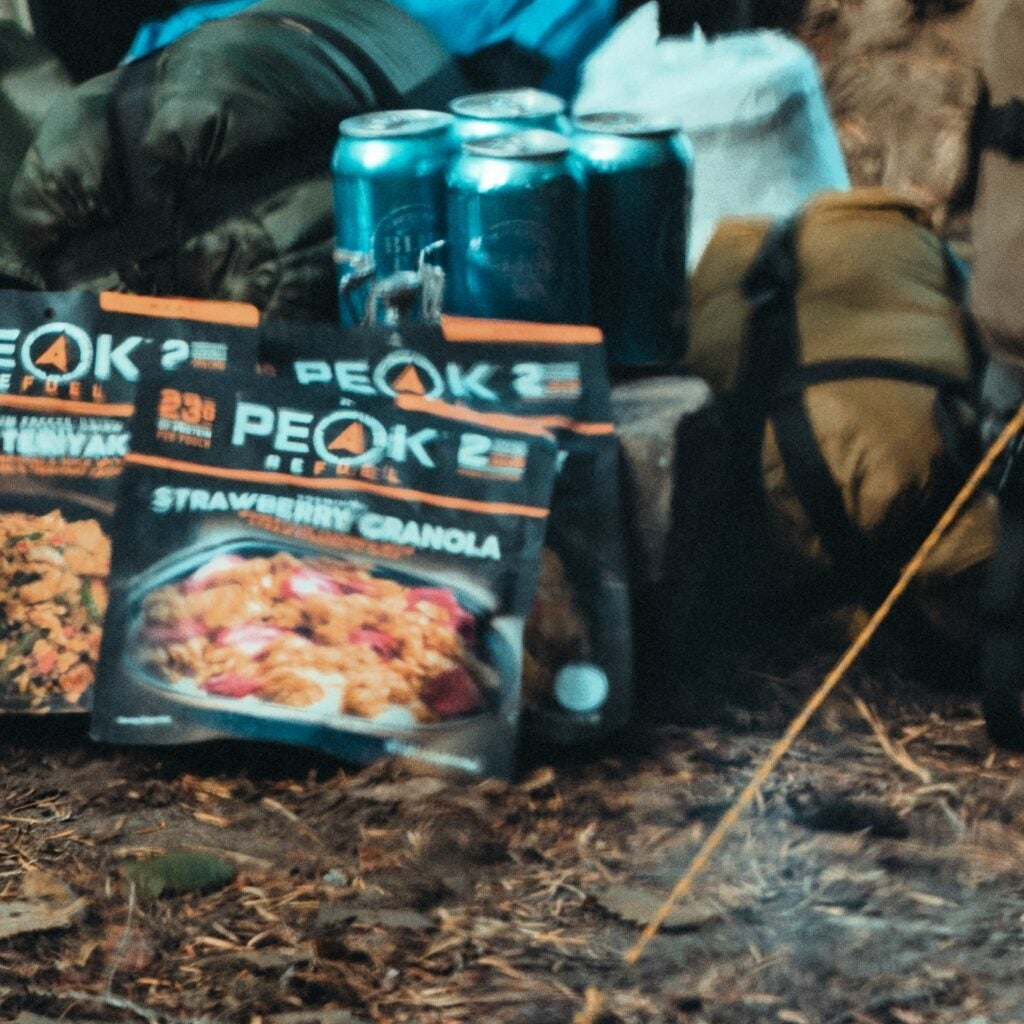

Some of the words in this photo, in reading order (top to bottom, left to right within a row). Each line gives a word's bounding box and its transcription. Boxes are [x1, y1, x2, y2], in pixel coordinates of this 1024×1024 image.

[0, 374, 106, 402] EFUEL
[3, 429, 131, 458] TERIYAK
[151, 486, 355, 531] STRAWBERRY
[358, 512, 501, 561] GRANOLA
